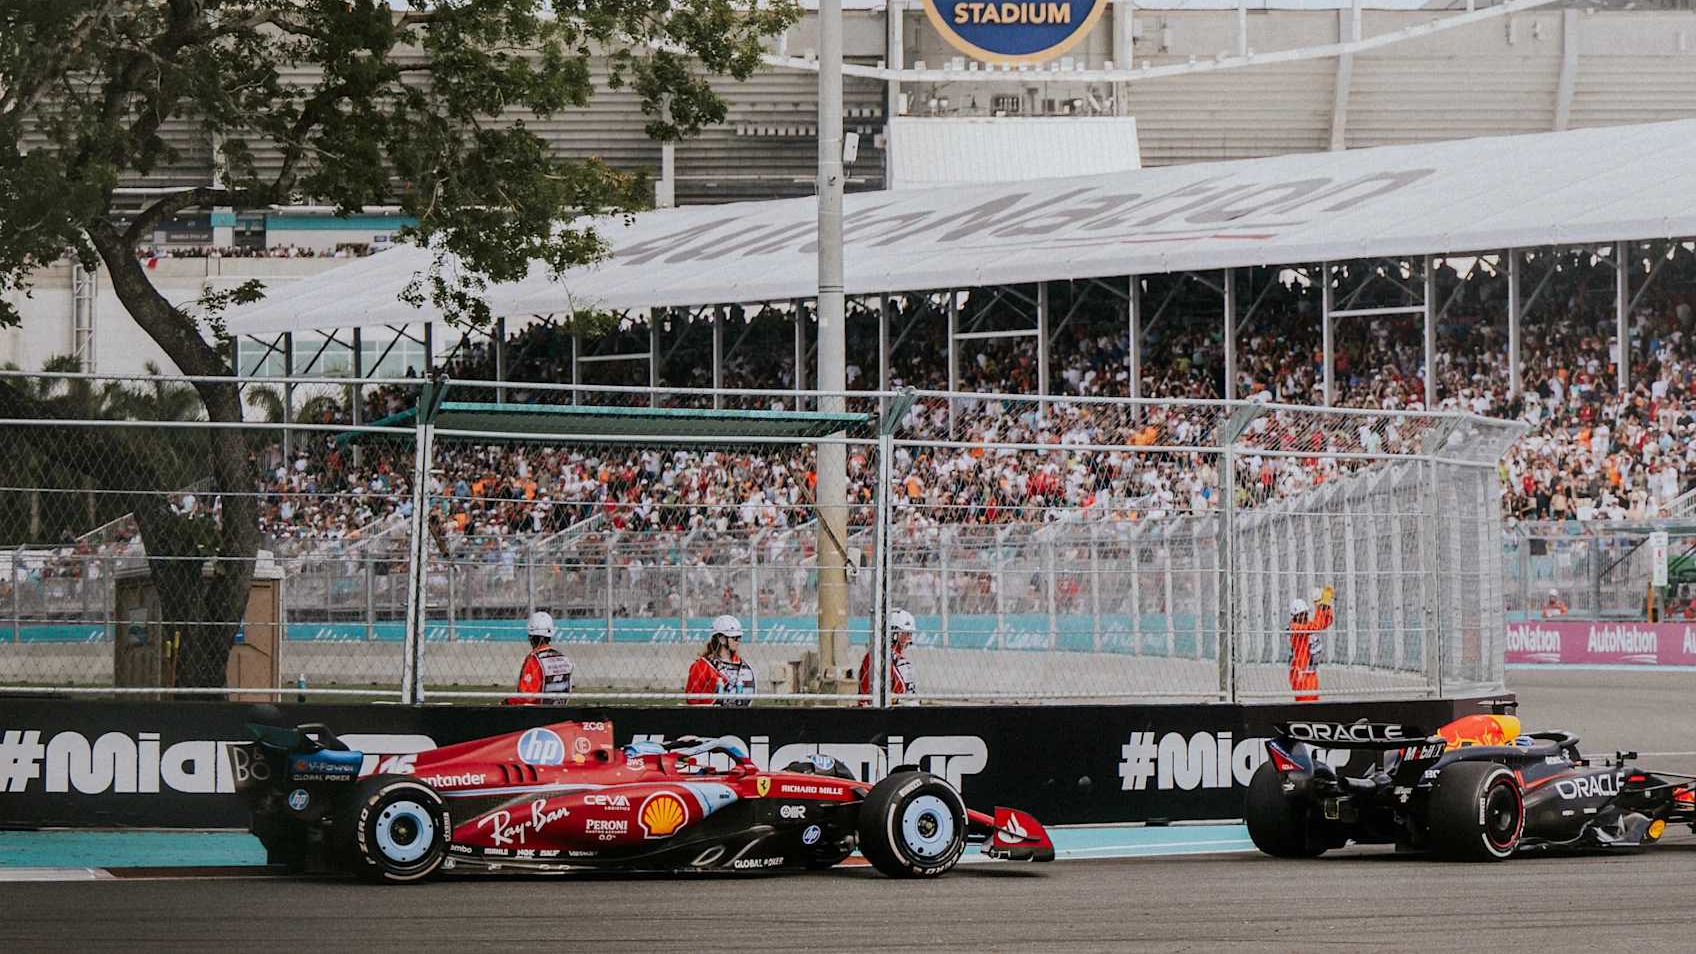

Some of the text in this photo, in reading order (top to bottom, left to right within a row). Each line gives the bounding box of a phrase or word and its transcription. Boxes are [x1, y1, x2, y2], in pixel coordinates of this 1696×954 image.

[954, 2, 1071, 24] STADIUM
[1506, 625, 1560, 652] toNation
[1587, 625, 1657, 653] AutoNation
[582, 722, 604, 730] ZCG
[1290, 724, 1402, 740] ORACLE
[524, 728, 560, 765] hp
[1404, 745, 1435, 761] Mobil
[308, 762, 354, 772] V-Power
[379, 754, 418, 775] 16
[420, 773, 486, 788] ntander
[781, 785, 844, 795] RICHARD MILLE
[293, 790, 307, 810] hp
[586, 819, 628, 830] PERONI
[804, 826, 818, 844] hp
[734, 857, 784, 868] GLOBAL POKER
